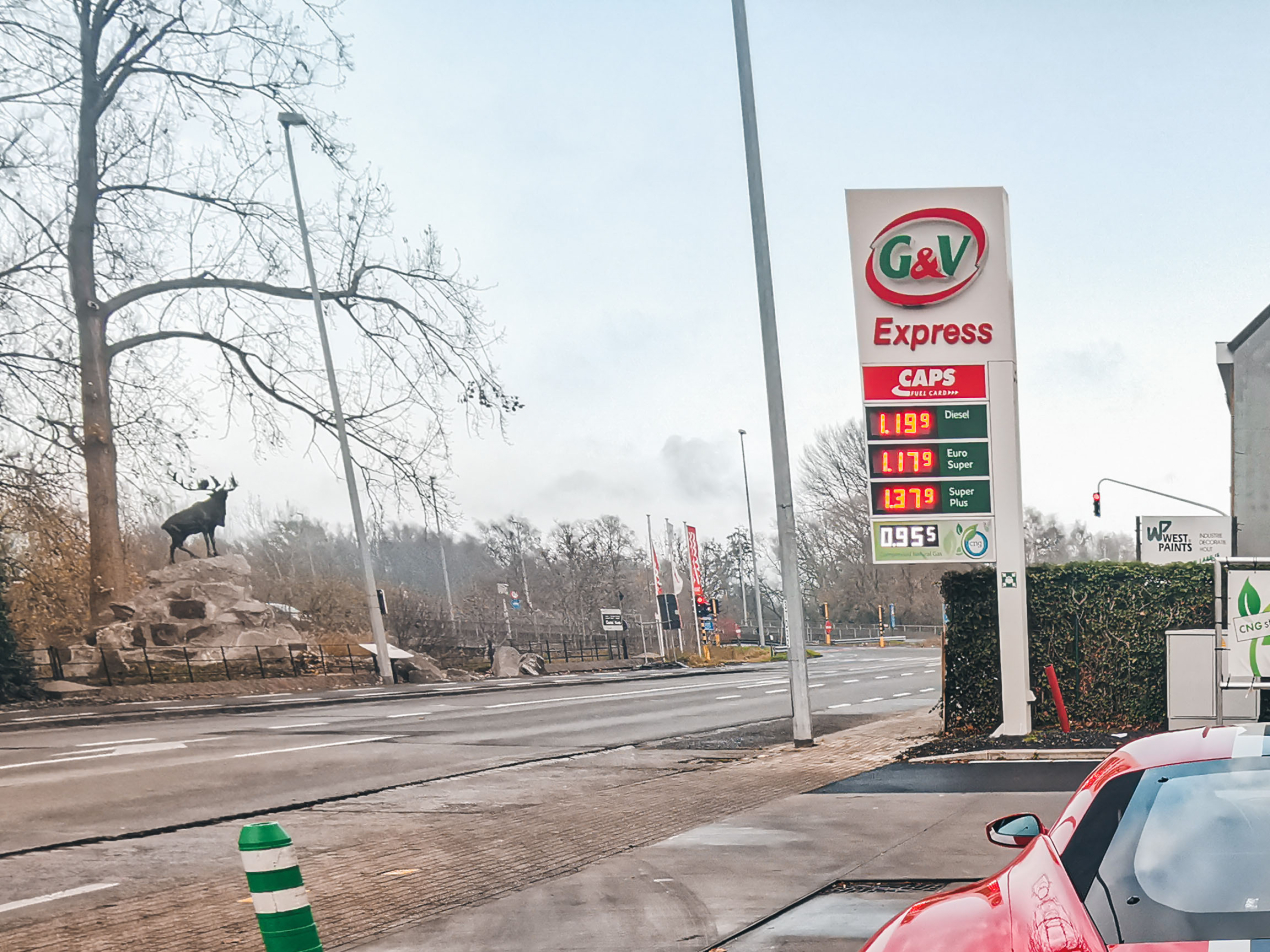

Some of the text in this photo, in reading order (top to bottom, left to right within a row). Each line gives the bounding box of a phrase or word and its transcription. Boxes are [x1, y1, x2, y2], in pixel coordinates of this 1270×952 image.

[879, 235, 972, 280] G&V
[873, 317, 993, 351] Express
[898, 368, 957, 387] CAPS
[944, 409, 970, 419] Diesel
[947, 448, 968, 458] Euro
[947, 460, 974, 471] Super
[948, 487, 975, 497] Super
[949, 498, 968, 507] Plus
[1163, 534, 1188, 542] WEST
[1158, 543, 1192, 552] PAINTS
[1239, 621, 1262, 633] CNG
